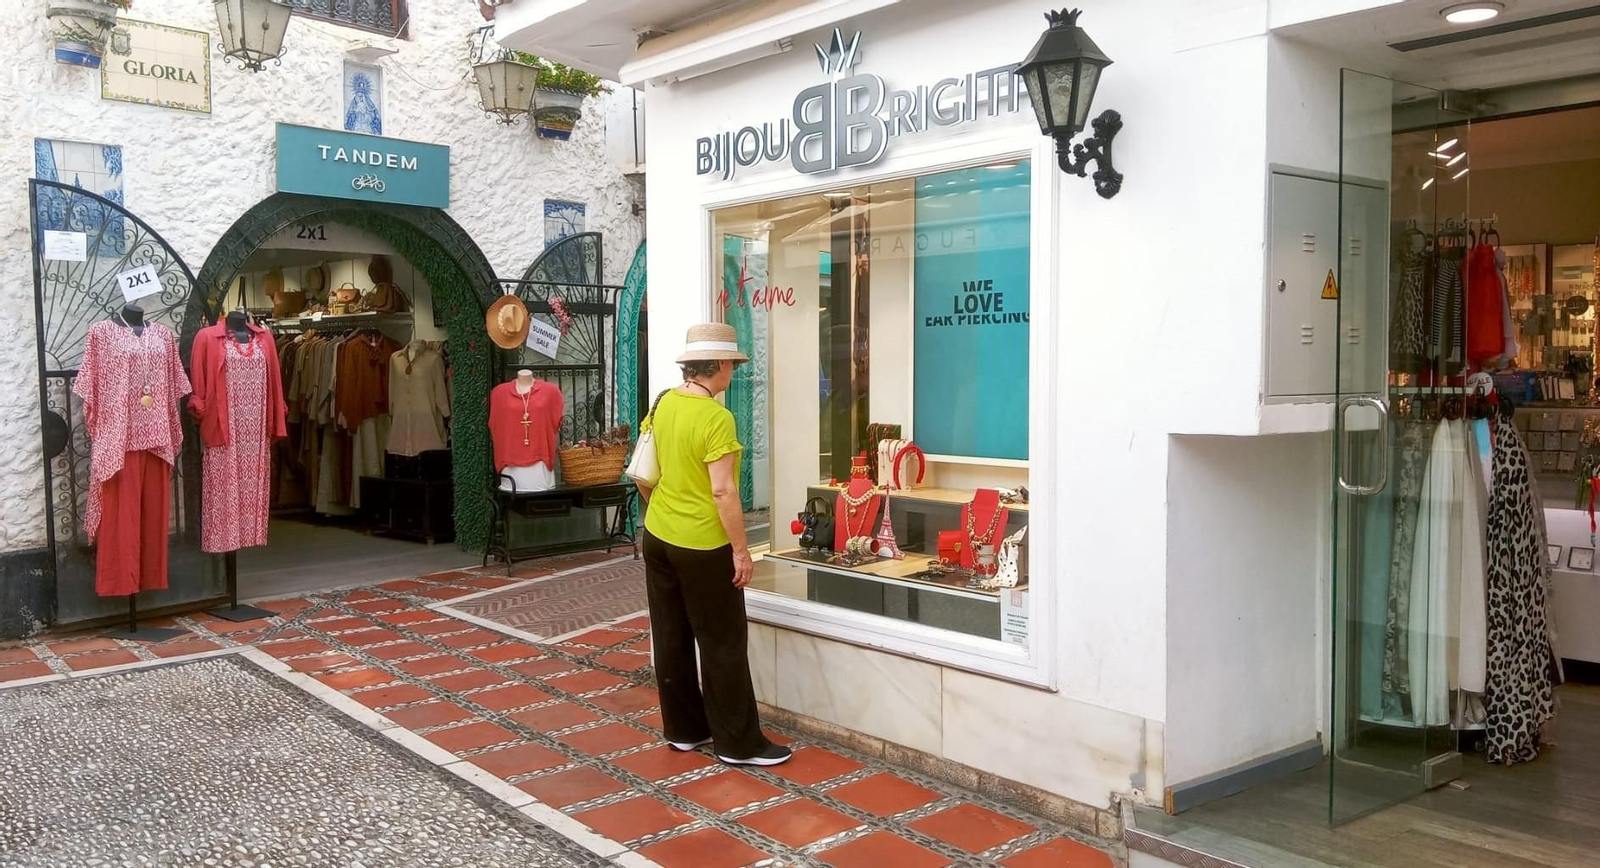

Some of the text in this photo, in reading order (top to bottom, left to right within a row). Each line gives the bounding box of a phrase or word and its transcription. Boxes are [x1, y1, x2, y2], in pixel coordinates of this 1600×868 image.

[123, 59, 198, 85] GLORIA
[317, 144, 418, 171] TANDEM
[696, 117, 790, 181] BIJOU
[296, 224, 328, 241] 2x1
[125, 270, 152, 289] 2X1
[962, 279, 994, 293] WE
[953, 292, 1004, 315] LOVE
[532, 325, 557, 342] SUMMER
[536, 337, 550, 349] SALE
